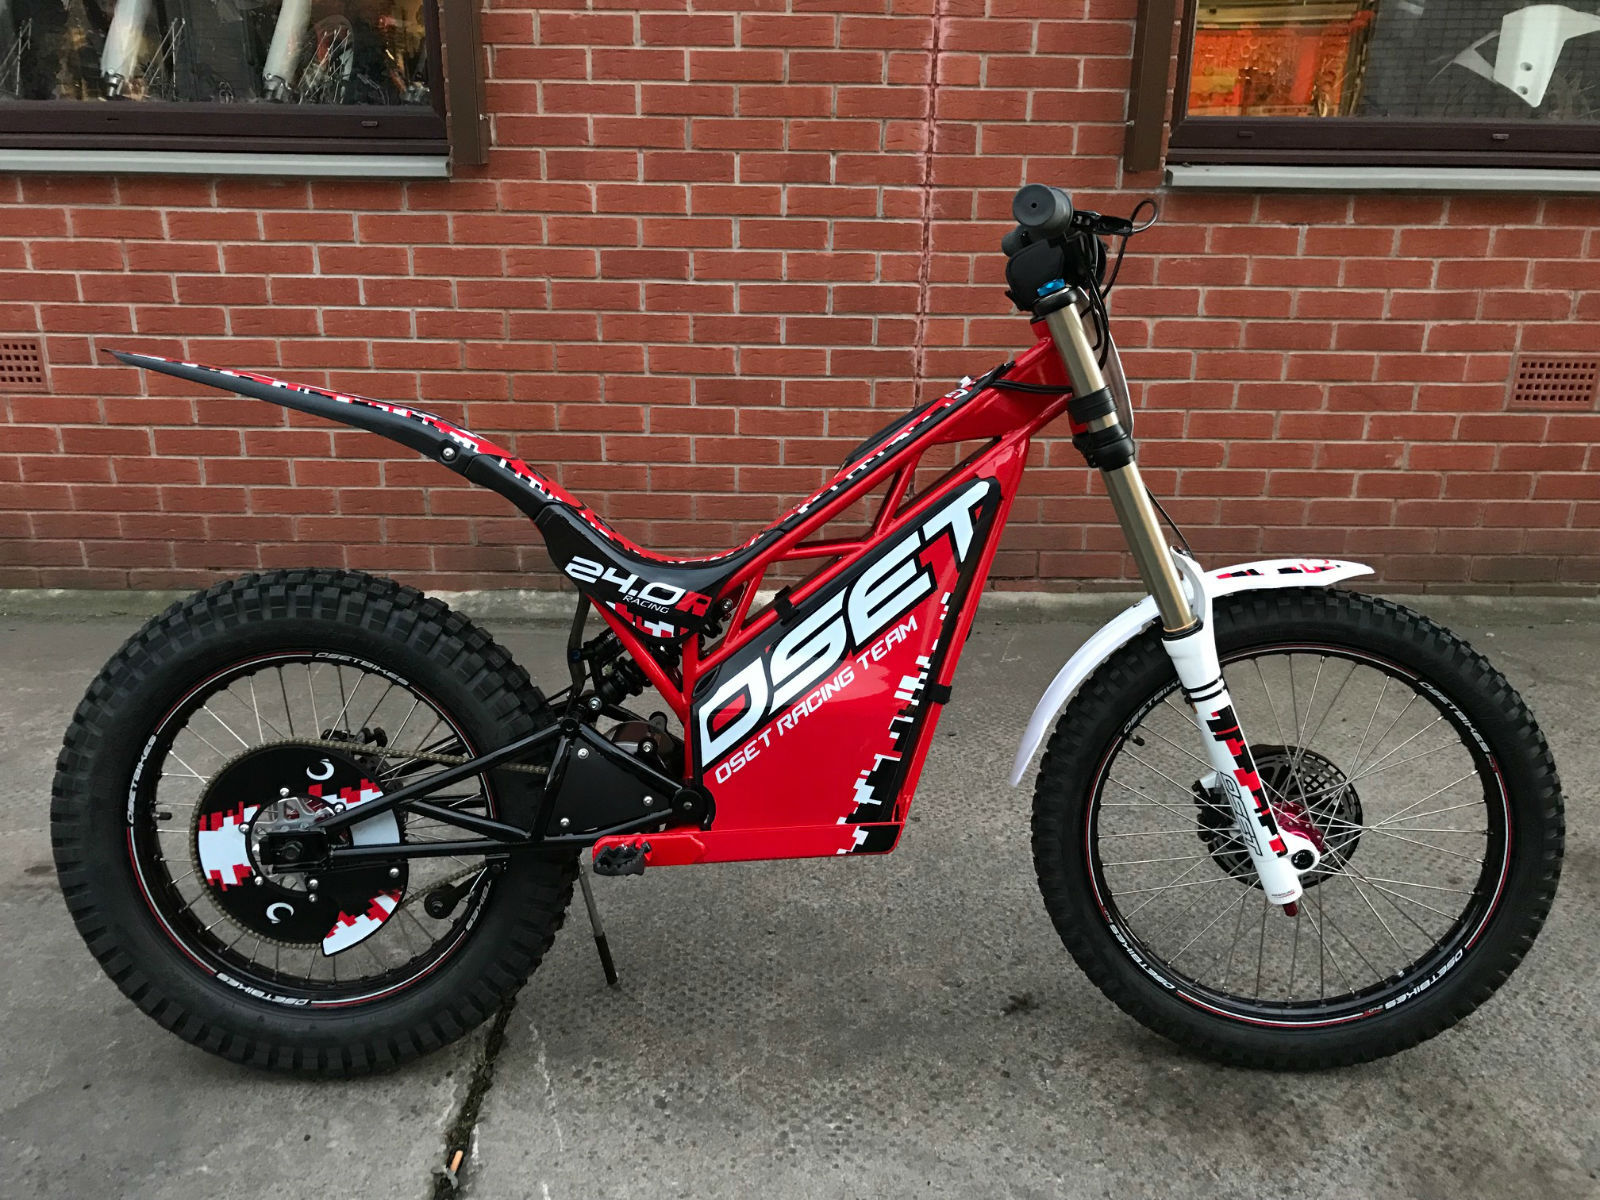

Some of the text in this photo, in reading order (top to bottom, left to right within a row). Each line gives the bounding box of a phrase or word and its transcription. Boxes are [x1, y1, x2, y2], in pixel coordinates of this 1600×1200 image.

[623, 594, 669, 614] RACING
[698, 481, 990, 767] OSET
[314, 652, 409, 687] OSETBIKES
[715, 615, 918, 784] OSET RACING TEAM
[1123, 679, 1182, 735] OSETBIK
[1417, 681, 1490, 754] OSETBIKES
[128, 734, 158, 825] OSETBIKES
[1219, 772, 1263, 857] OSET
[216, 971, 311, 1006] OSETBIKES
[1110, 922, 1176, 990] OSETBIKES
[1384, 948, 1464, 1010] OSETBIKES
